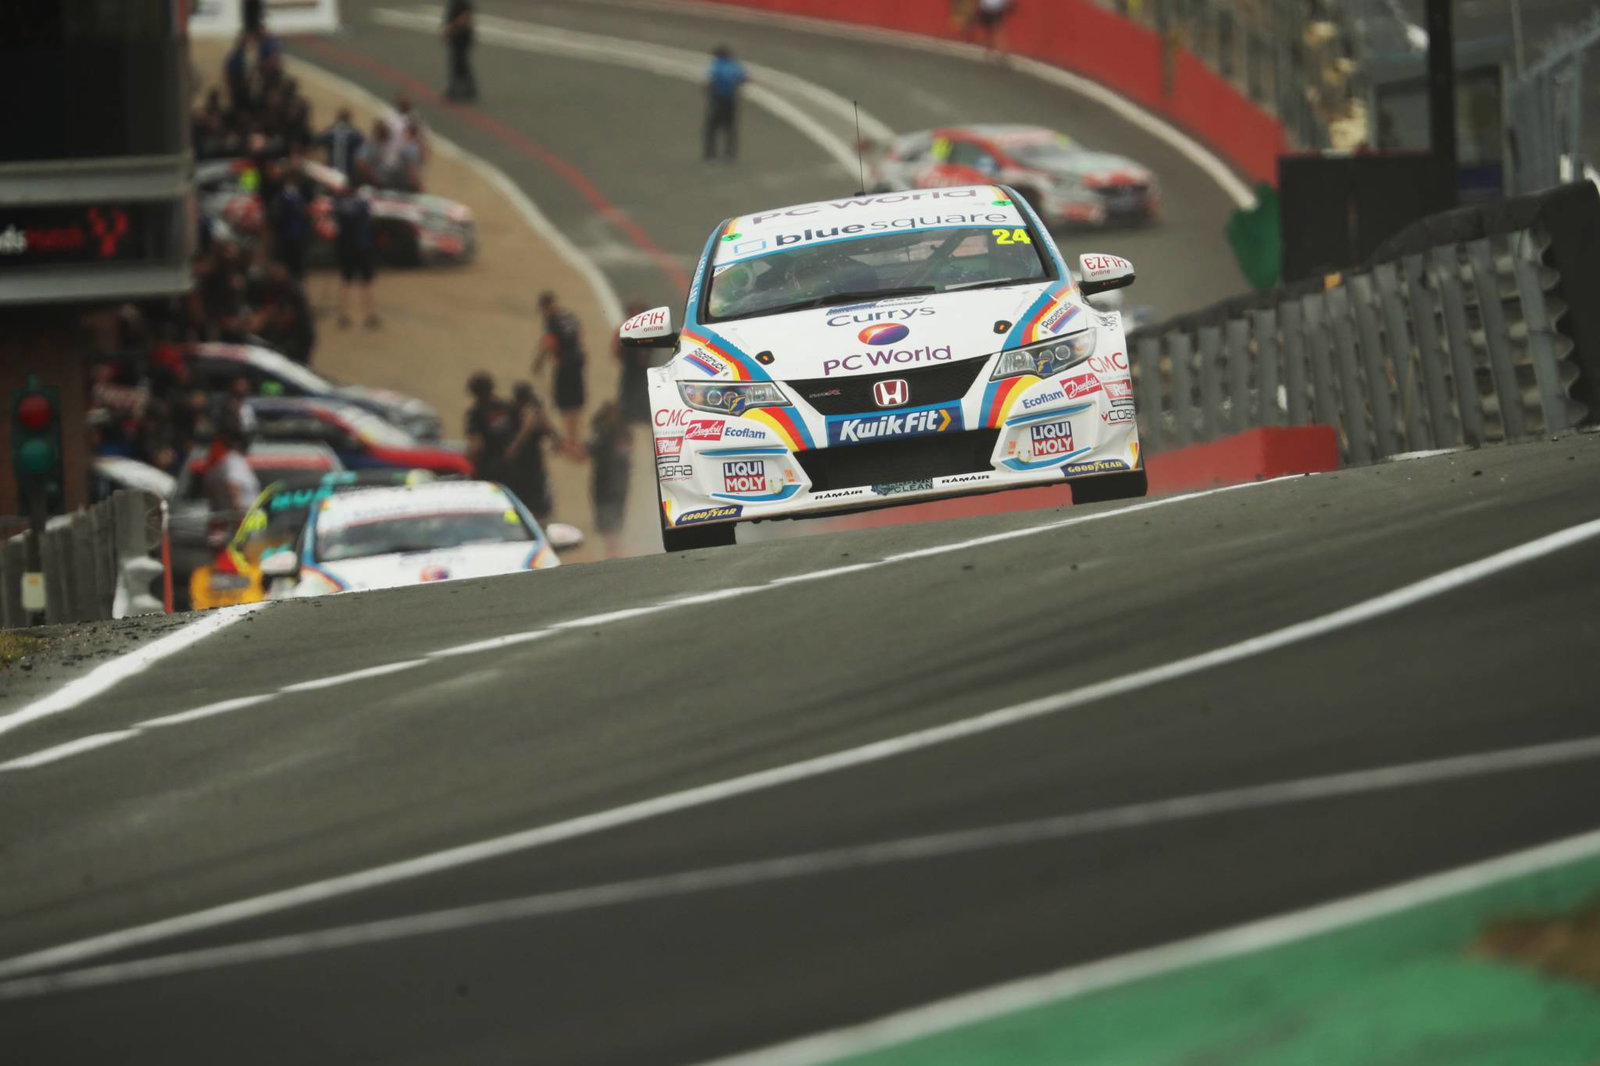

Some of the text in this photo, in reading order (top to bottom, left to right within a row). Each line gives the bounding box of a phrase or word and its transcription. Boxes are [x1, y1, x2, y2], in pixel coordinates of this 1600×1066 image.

[752, 204, 820, 225] PC
[992, 228, 1031, 246] 24
[826, 307, 936, 327] Currys
[823, 345, 952, 376] PC World
[1087, 352, 1127, 373] CMC
[1023, 389, 1064, 409] Ecoflam
[655, 409, 693, 427] CMC
[725, 427, 766, 439] Ecoflam
[1032, 423, 1071, 440] LIQUI
[1034, 439, 1073, 456] MOLY
[724, 462, 763, 477] LIQUI
[1067, 461, 1123, 473] GOODYEAR
[726, 476, 764, 492] MOLY
[941, 475, 990, 484] RAMAIR
[815, 490, 863, 500] RAMAIR
[682, 507, 737, 522] GOODYEAR
